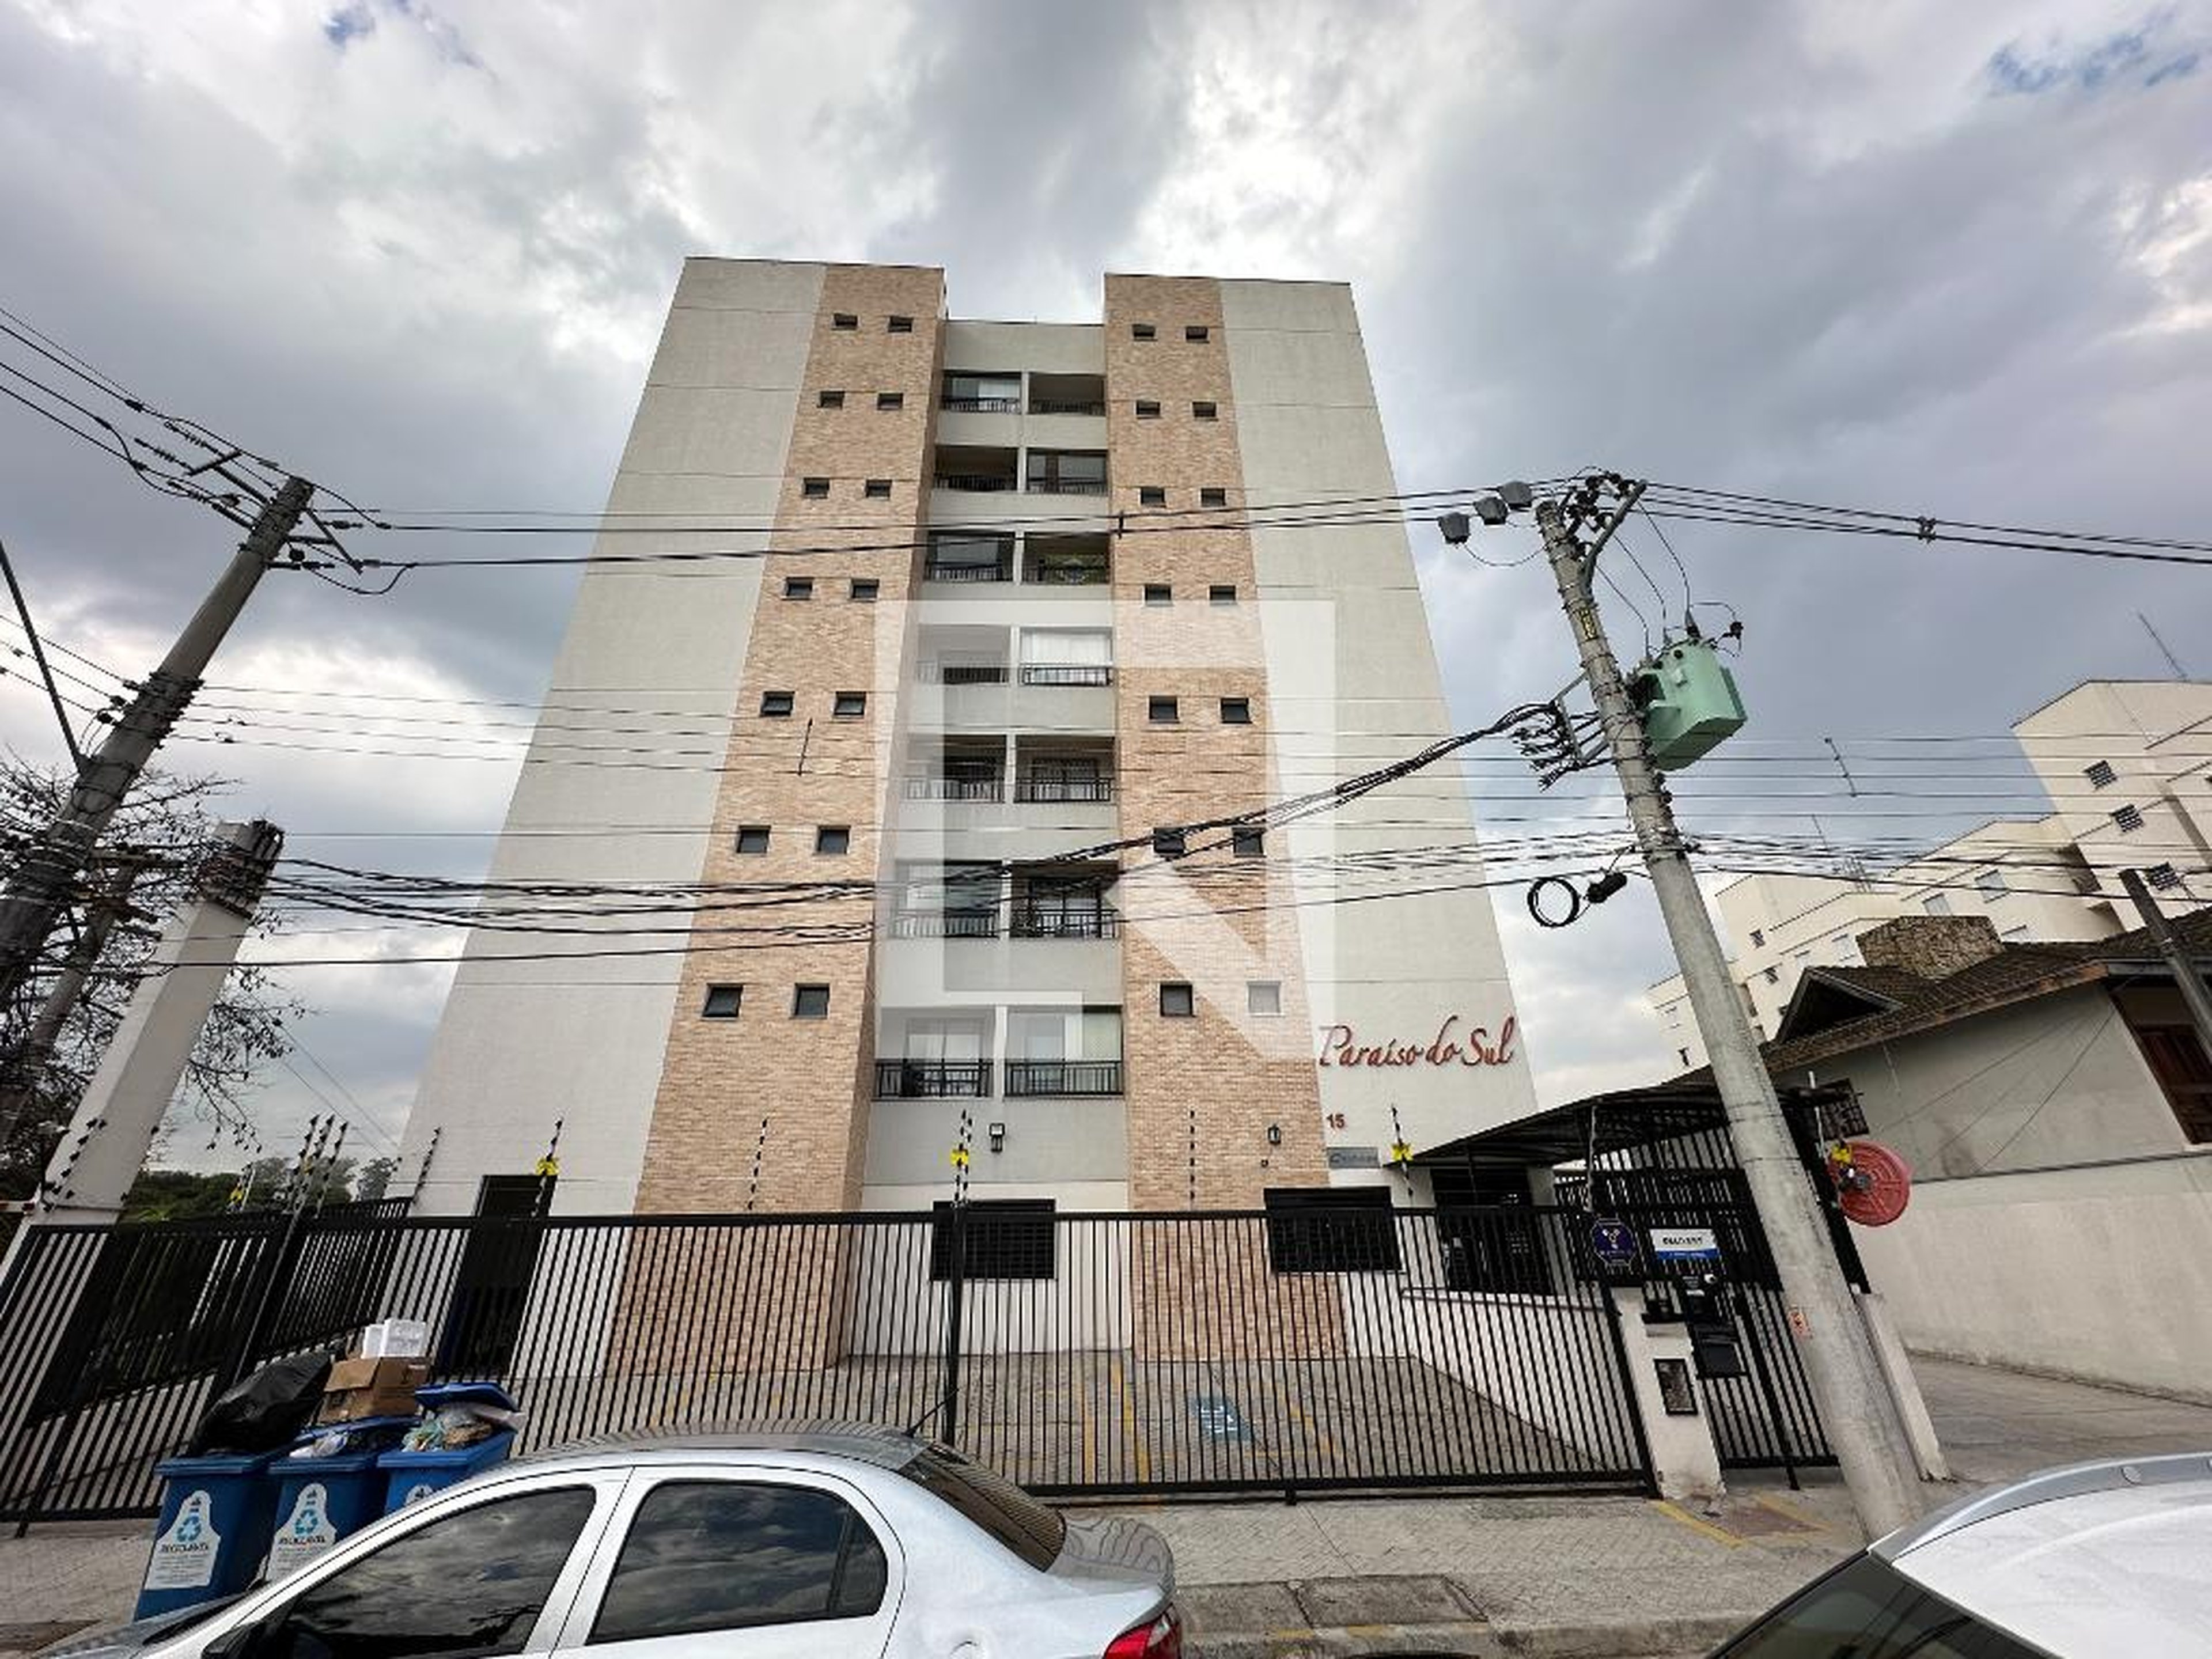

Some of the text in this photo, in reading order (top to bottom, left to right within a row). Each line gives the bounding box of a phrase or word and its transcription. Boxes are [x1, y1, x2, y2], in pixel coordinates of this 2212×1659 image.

[1425, 1014, 1462, 1066] do
[1461, 1016, 1514, 1066] Sul
[1327, 1113, 1345, 1129] 15
